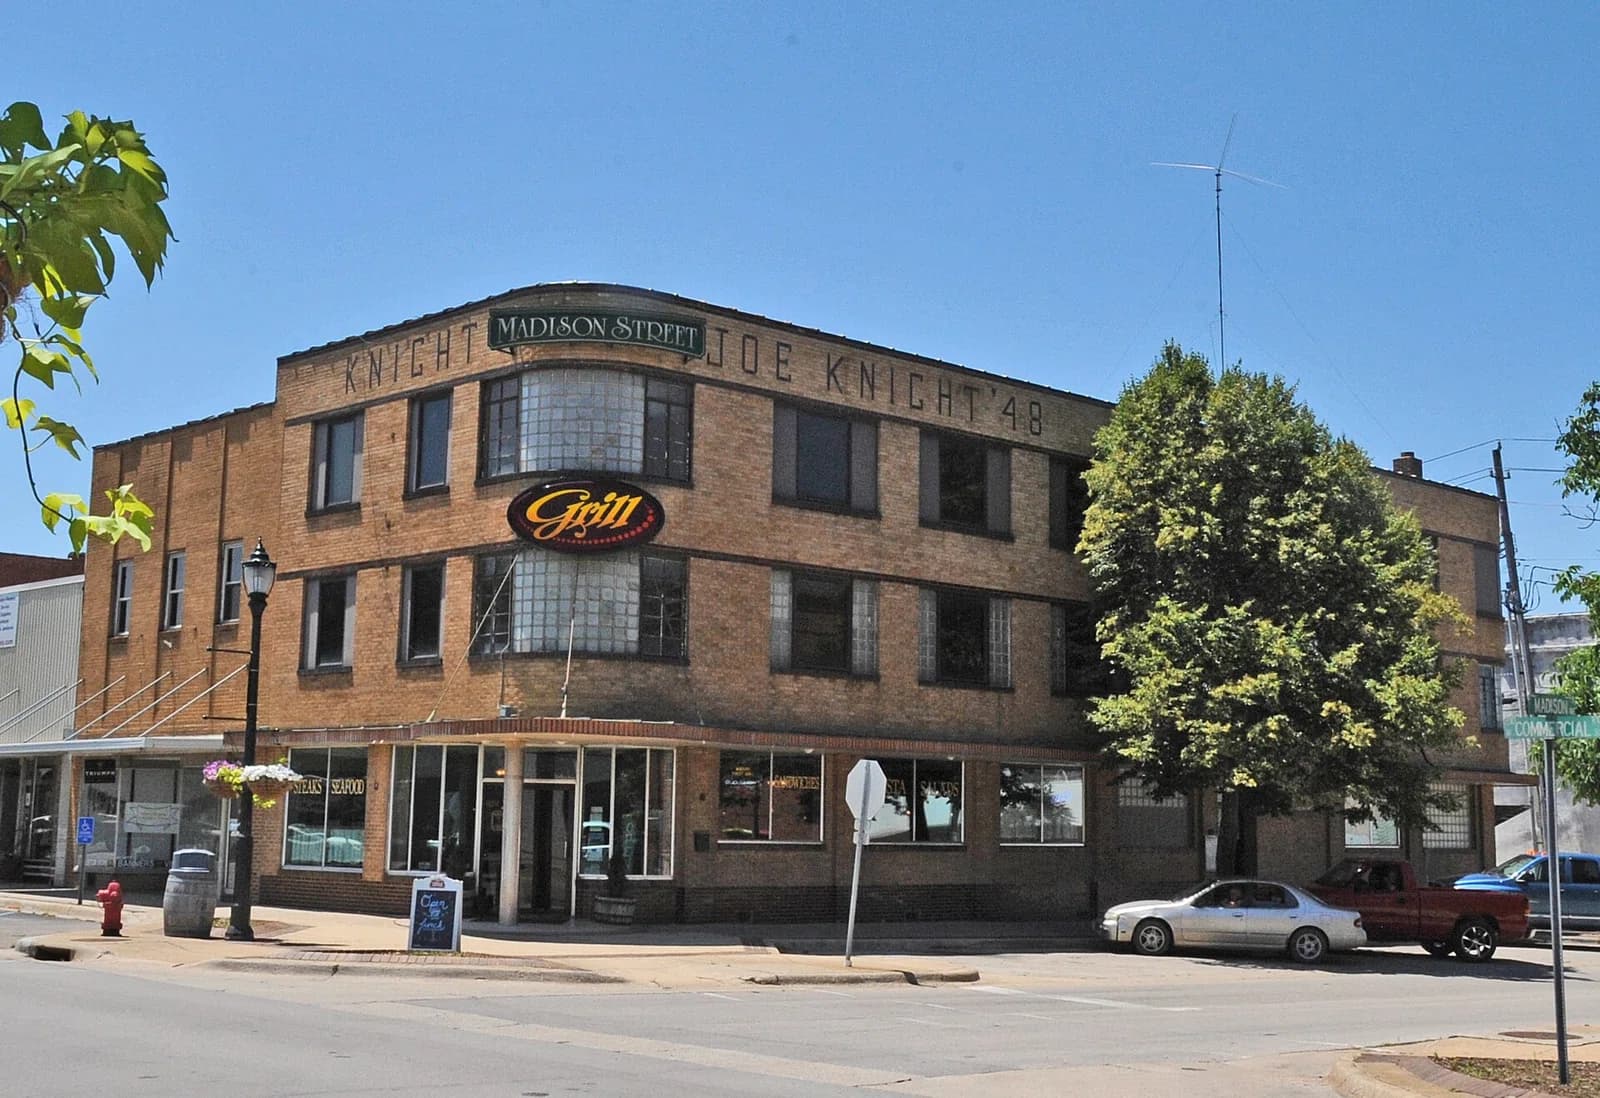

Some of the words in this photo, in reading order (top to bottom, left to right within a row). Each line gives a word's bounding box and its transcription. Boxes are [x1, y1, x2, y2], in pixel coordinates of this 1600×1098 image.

[498, 316, 607, 341] MADISON
[611, 316, 699, 349] STREET
[345, 321, 478, 394] KNIGHT
[706, 328, 793, 383] JOE
[826, 352, 980, 422] KNIGHT
[990, 386, 1043, 436] '48
[525, 489, 643, 540] Grill
[1534, 697, 1569, 714] MADISON
[1515, 720, 1590, 737] COMMERCIAL
[293, 779, 323, 795] STEAKS
[331, 779, 365, 795] SEAFOOD
[886, 779, 907, 795] STA
[920, 780, 960, 797] SALADS
